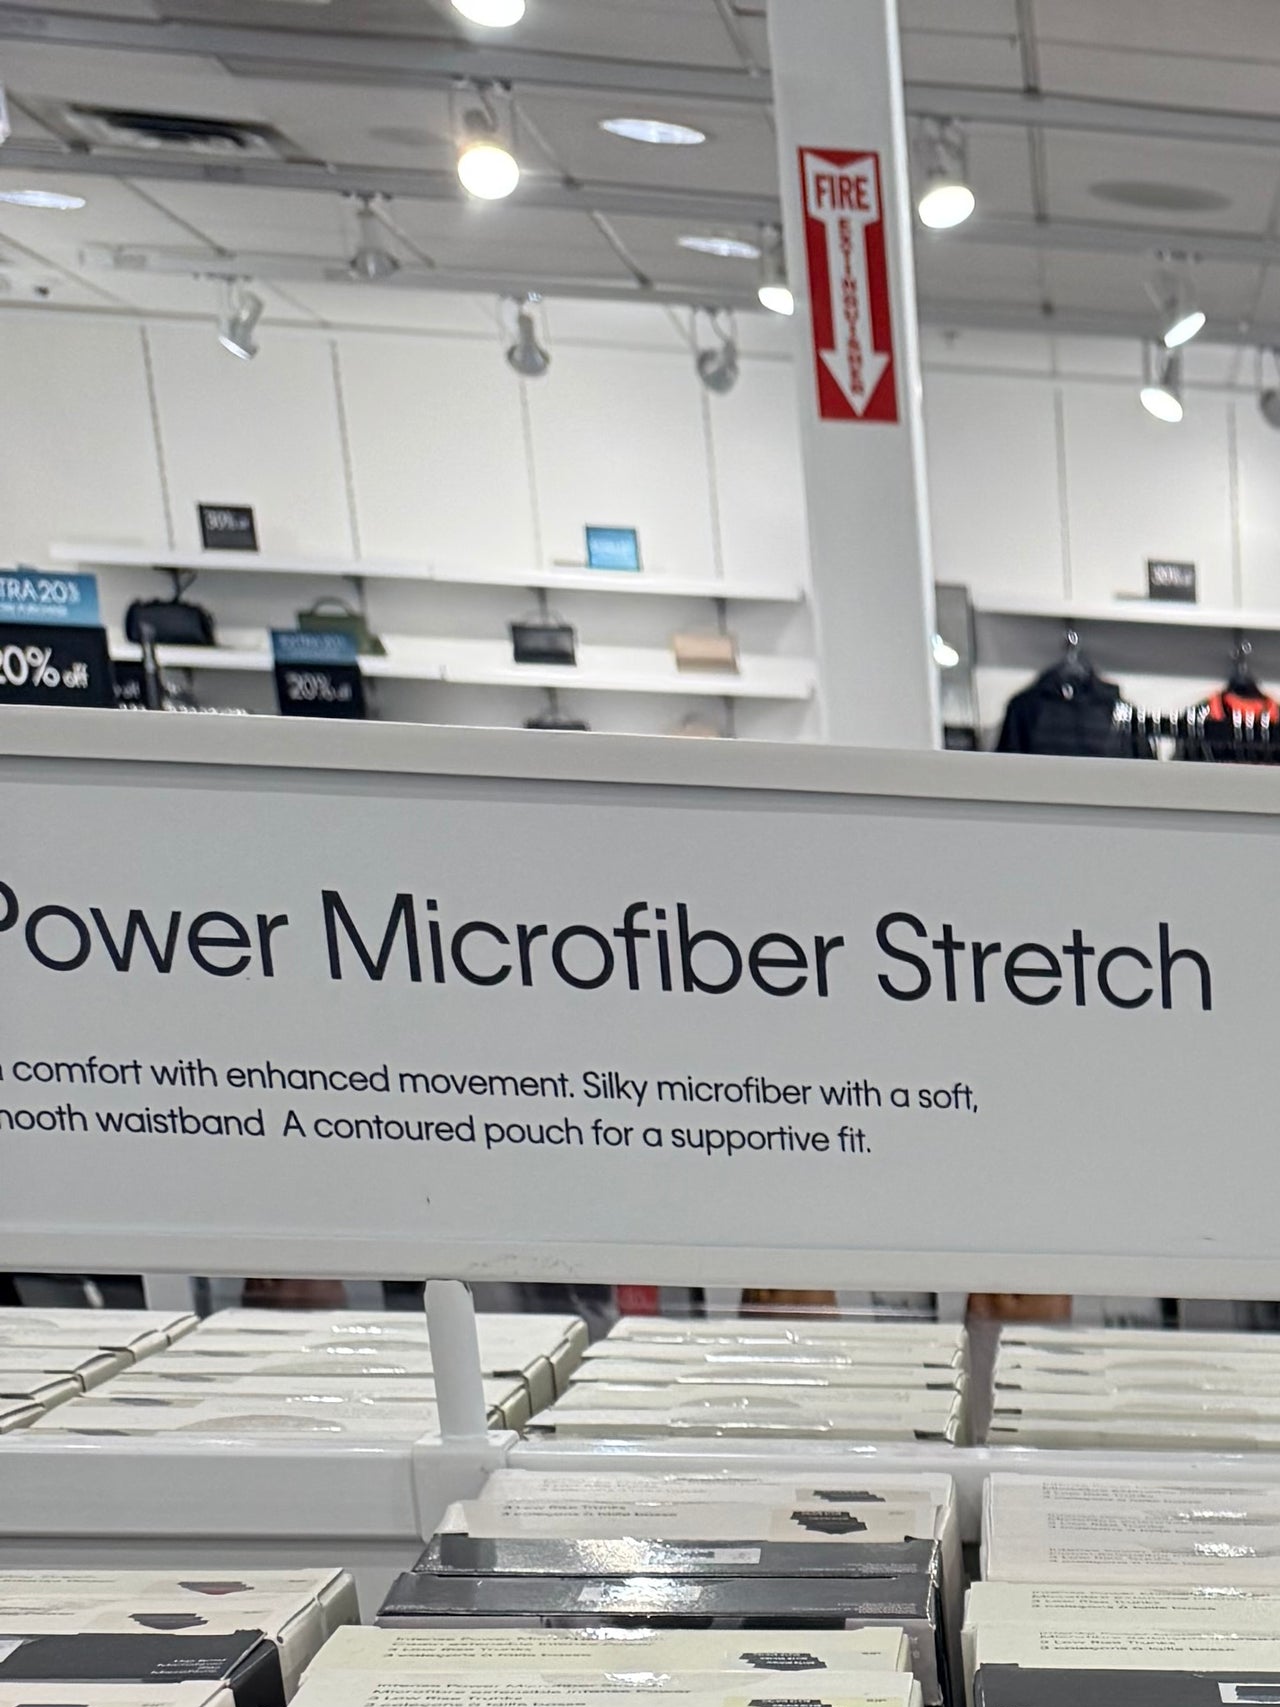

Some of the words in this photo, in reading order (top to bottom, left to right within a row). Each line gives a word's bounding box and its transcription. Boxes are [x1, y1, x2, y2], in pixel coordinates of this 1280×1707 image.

[814, 172, 870, 211] FIRE
[322, 890, 844, 997] Microfiber
[876, 912, 1211, 1010] Stretch
[12, 1055, 143, 1086] comfort
[149, 1058, 219, 1088] with
[226, 1060, 391, 1093] enhanced
[398, 1072, 575, 1099] movement.
[582, 1070, 648, 1108] Silky
[656, 1075, 813, 1105] microfiber
[819, 1078, 882, 1108] with
[890, 1088, 909, 1107] a
[918, 1082, 978, 1114] soft,
[94, 1105, 266, 1137] waistband
[282, 1109, 307, 1138] A
[313, 1114, 476, 1143] contoured
[483, 1116, 584, 1150] pouch
[590, 1118, 635, 1147] for
[643, 1128, 663, 1147] a
[670, 1125, 830, 1157] supportive
[836, 1125, 872, 1154] fit.
